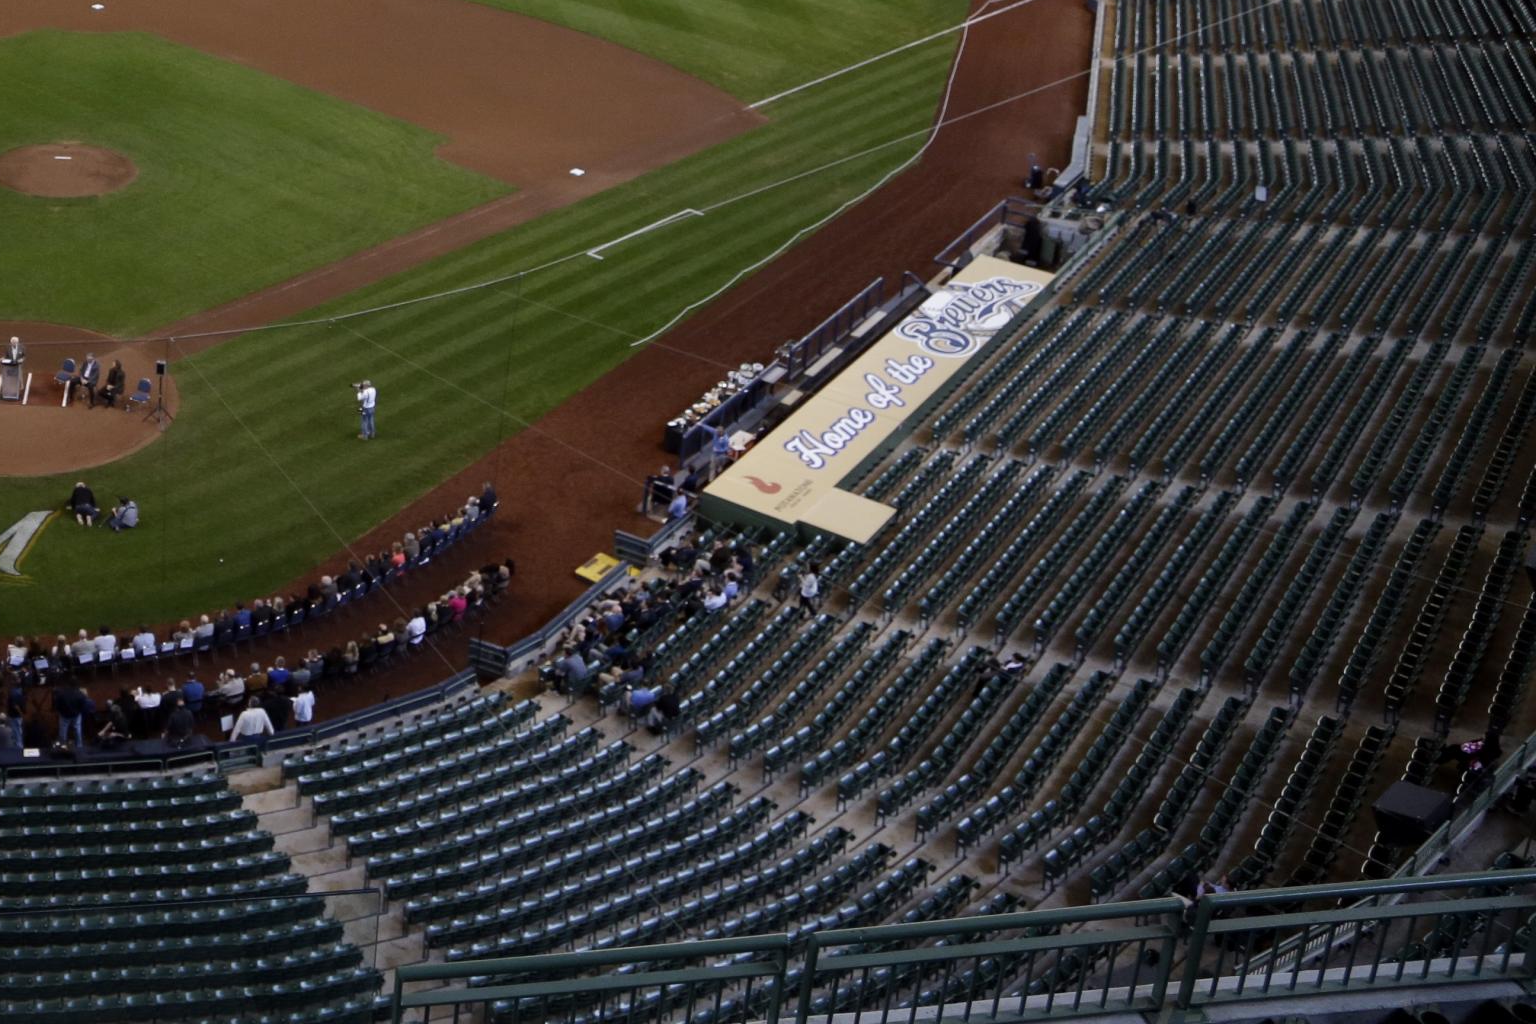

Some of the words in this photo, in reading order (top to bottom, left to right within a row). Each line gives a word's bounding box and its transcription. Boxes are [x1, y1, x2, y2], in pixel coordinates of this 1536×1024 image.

[894, 276, 1042, 358] Brewers
[865, 371, 906, 410] of
[884, 352, 935, 393] the
[784, 405, 874, 470] Home
